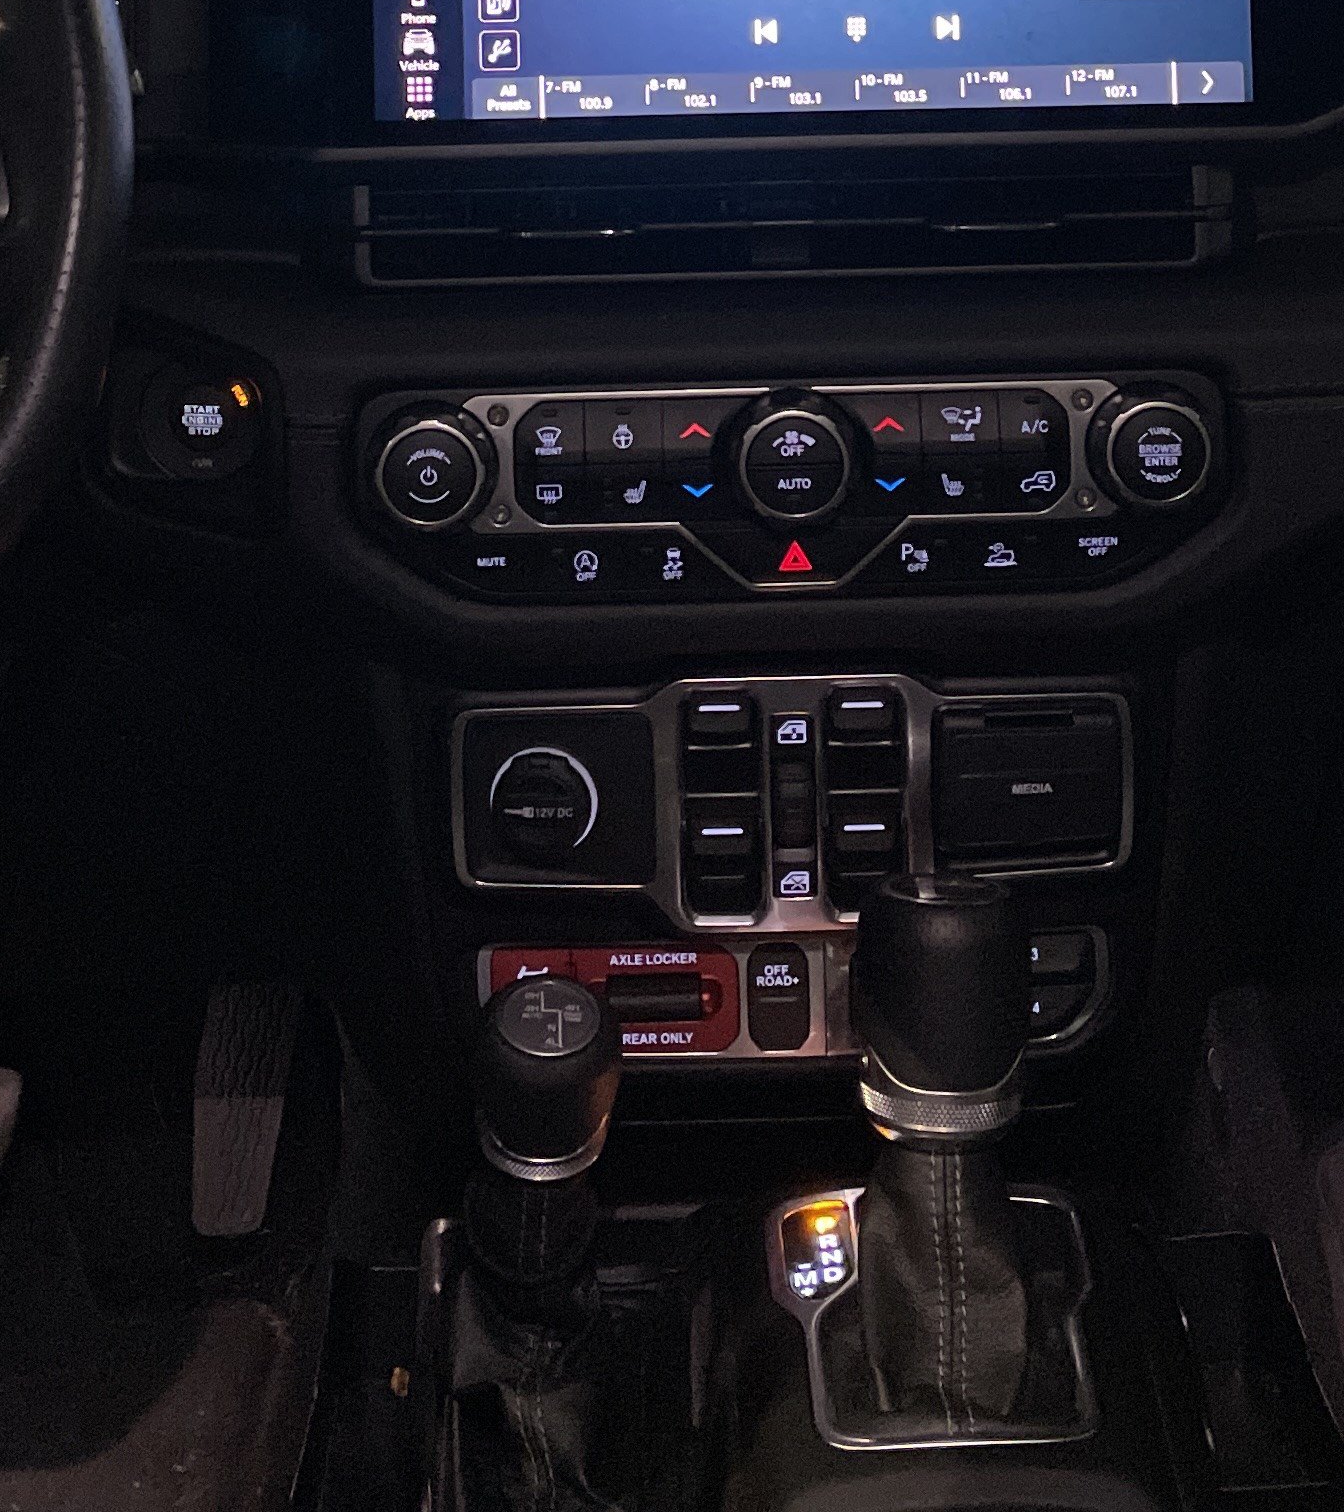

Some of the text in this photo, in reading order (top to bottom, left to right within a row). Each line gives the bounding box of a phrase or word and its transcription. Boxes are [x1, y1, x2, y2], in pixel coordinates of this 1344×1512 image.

[401, 12, 437, 25] Phone
[399, 59, 440, 72] Vehicle
[500, 84, 517, 98] All
[893, 89, 928, 103] 103.5
[998, 87, 1032, 101] 106.1
[1104, 84, 1137, 99] 107.1
[486, 98, 533, 112] Presets
[579, 96, 613, 111] 100.9
[684, 94, 717, 108] 102.1
[789, 92, 822, 106] 103.1
[405, 107, 436, 121] Apps
[183, 404, 221, 414] START
[188, 426, 220, 436] STOP
[1020, 419, 1049, 435] A/C
[1147, 426, 1172, 436] TUNE
[410, 447, 446, 461] VOLUME
[534, 446, 563, 456] FRONT
[780, 445, 805, 458] OFF
[1138, 443, 1182, 454] BROWSE
[1144, 456, 1179, 467] ENTER
[777, 477, 812, 490] AUTO
[1144, 472, 1179, 484] SCROLL
[1078, 537, 1119, 547] SCREEN
[901, 543, 914, 561] P
[1087, 547, 1108, 557] OFF
[476, 556, 507, 567] MUTE
[907, 562, 928, 573] OFF
[576, 571, 597, 582] OFF
[663, 570, 683, 581] OFF
[1011, 782, 1054, 795] MEDIA
[535, 807, 574, 819] 12V DC
[609, 952, 698, 966] AXLE LOCKER
[763, 964, 789, 976] OFF
[755, 975, 800, 987] ROAD+
[1031, 1000, 1041, 1015] 4
[622, 1032, 694, 1045] REAR ONLY
[818, 1233, 839, 1250] R
[821, 1249, 845, 1266] N
[793, 1270, 819, 1288] M
[823, 1267, 846, 1284] D
